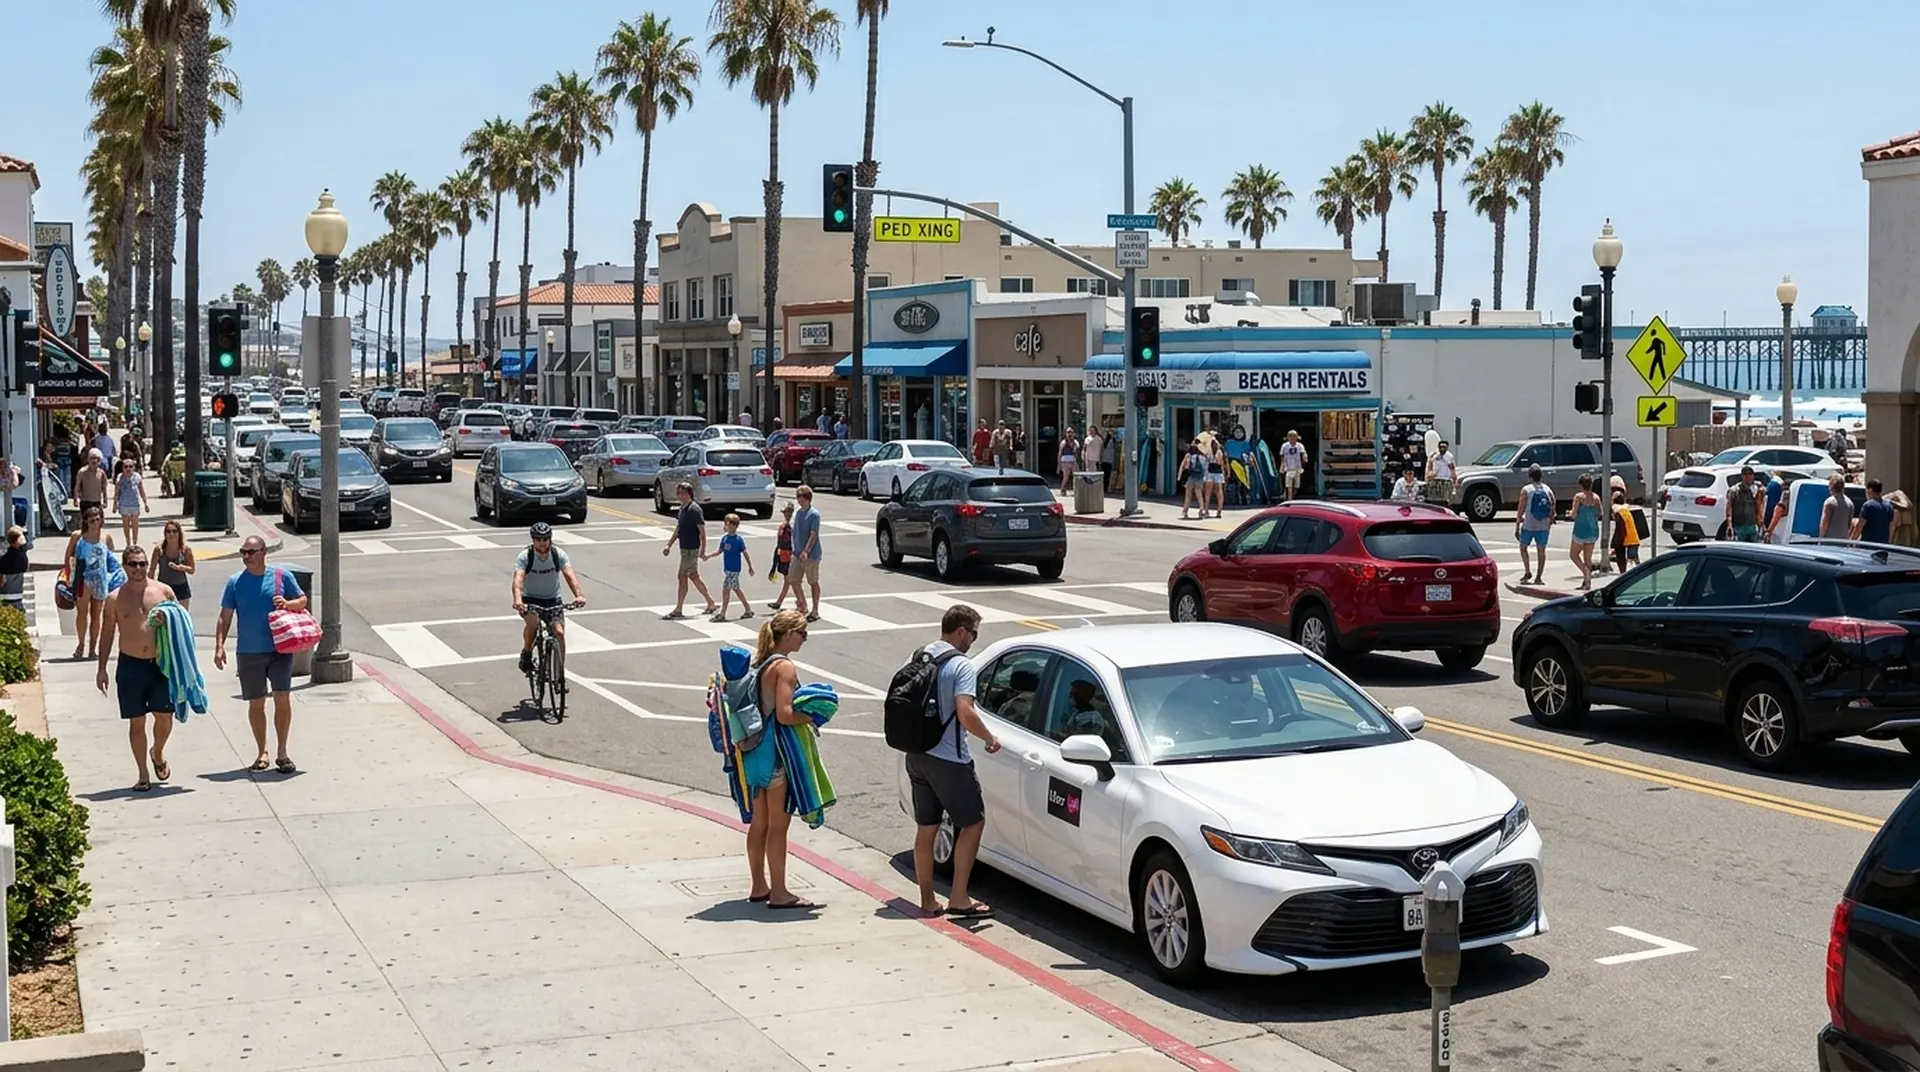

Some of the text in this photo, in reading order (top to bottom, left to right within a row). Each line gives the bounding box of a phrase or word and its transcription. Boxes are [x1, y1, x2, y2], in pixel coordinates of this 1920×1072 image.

[881, 222, 954, 238] PED XING
[1013, 324, 1041, 357] cafe
[1238, 372, 1292, 389] BEACH
[1297, 371, 1367, 389] RENTALS
